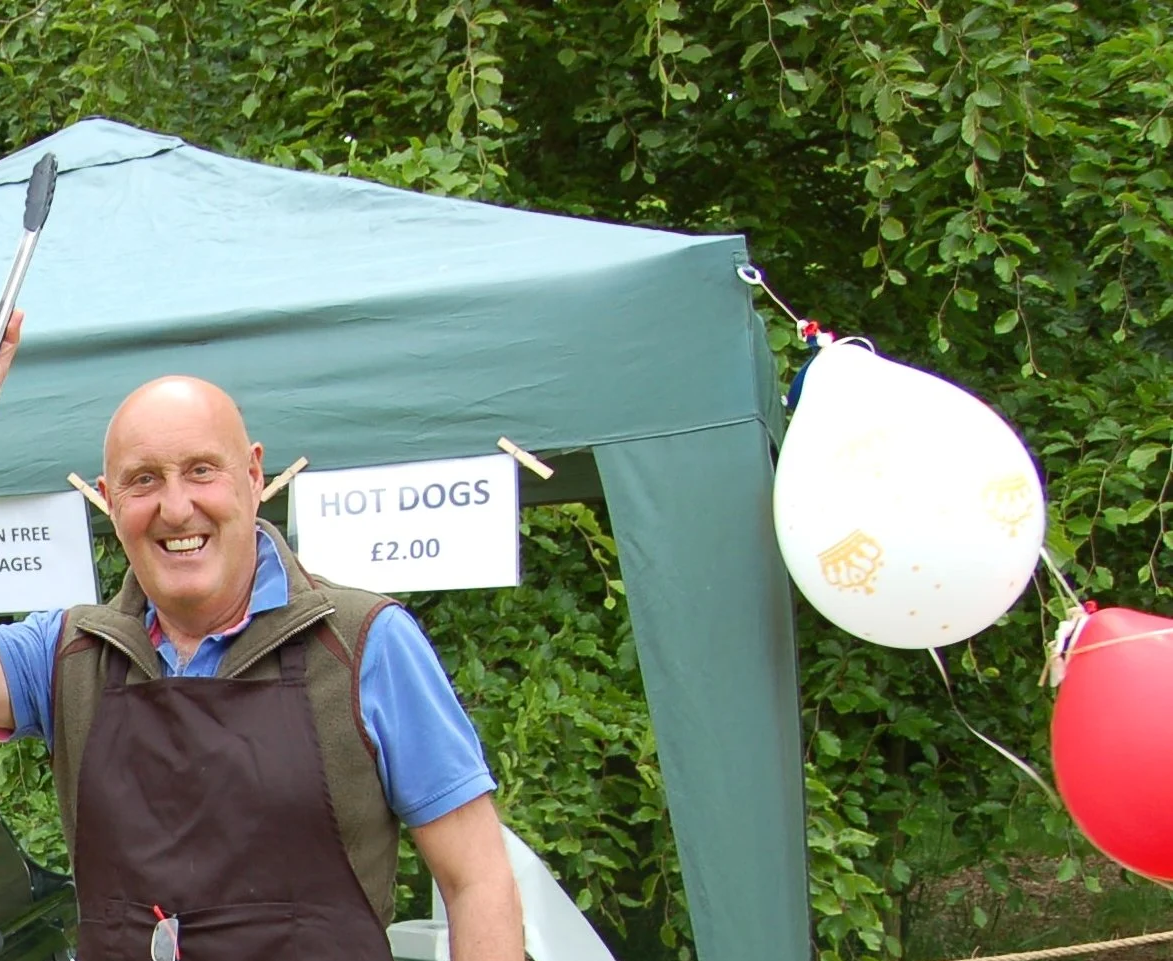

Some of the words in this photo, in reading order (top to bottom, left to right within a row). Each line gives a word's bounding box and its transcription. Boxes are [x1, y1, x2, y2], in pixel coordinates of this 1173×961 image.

[320, 488, 387, 517] HOT
[398, 479, 490, 511] DOGS
[11, 526, 51, 542] FREE
[370, 538, 441, 562] £2.00
